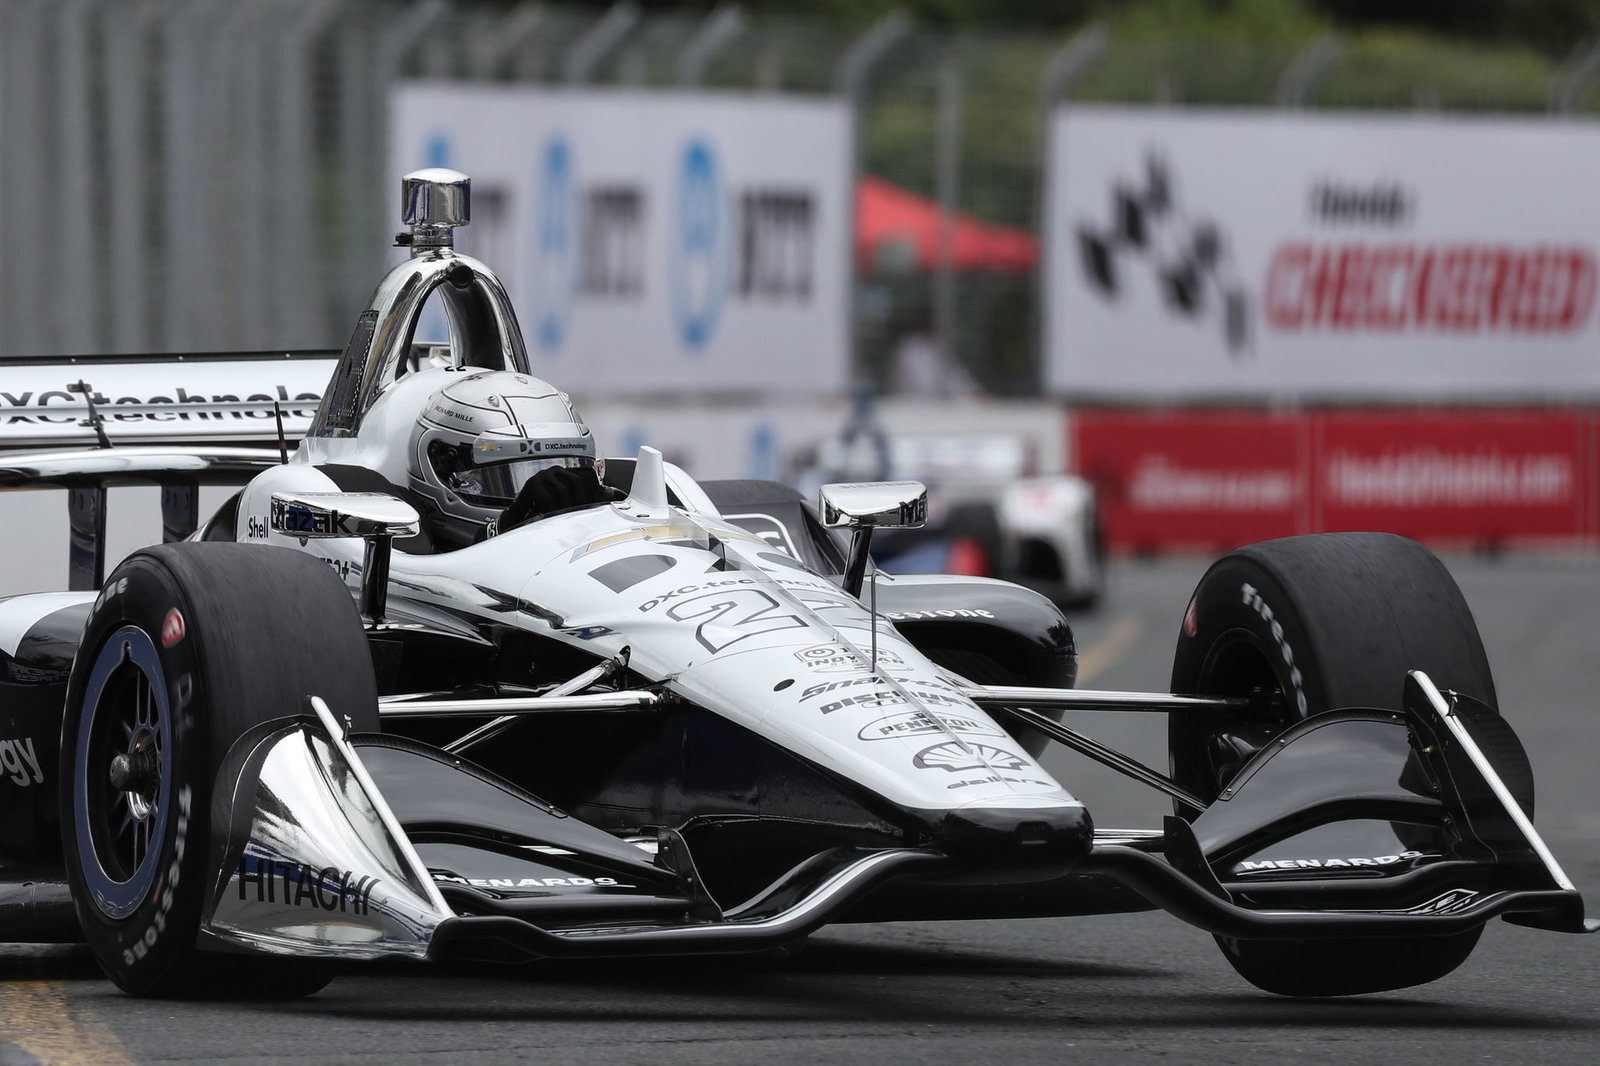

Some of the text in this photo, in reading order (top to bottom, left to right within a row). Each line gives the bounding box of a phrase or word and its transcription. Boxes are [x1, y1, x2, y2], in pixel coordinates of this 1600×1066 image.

[455, 412, 474, 423] MILLE
[248, 516, 269, 538] Shell
[807, 656, 905, 668] INDYAR
[1240, 850, 1423, 870] MENARDS
[238, 857, 381, 916] HITACHI
[433, 874, 618, 887] MENARDS
